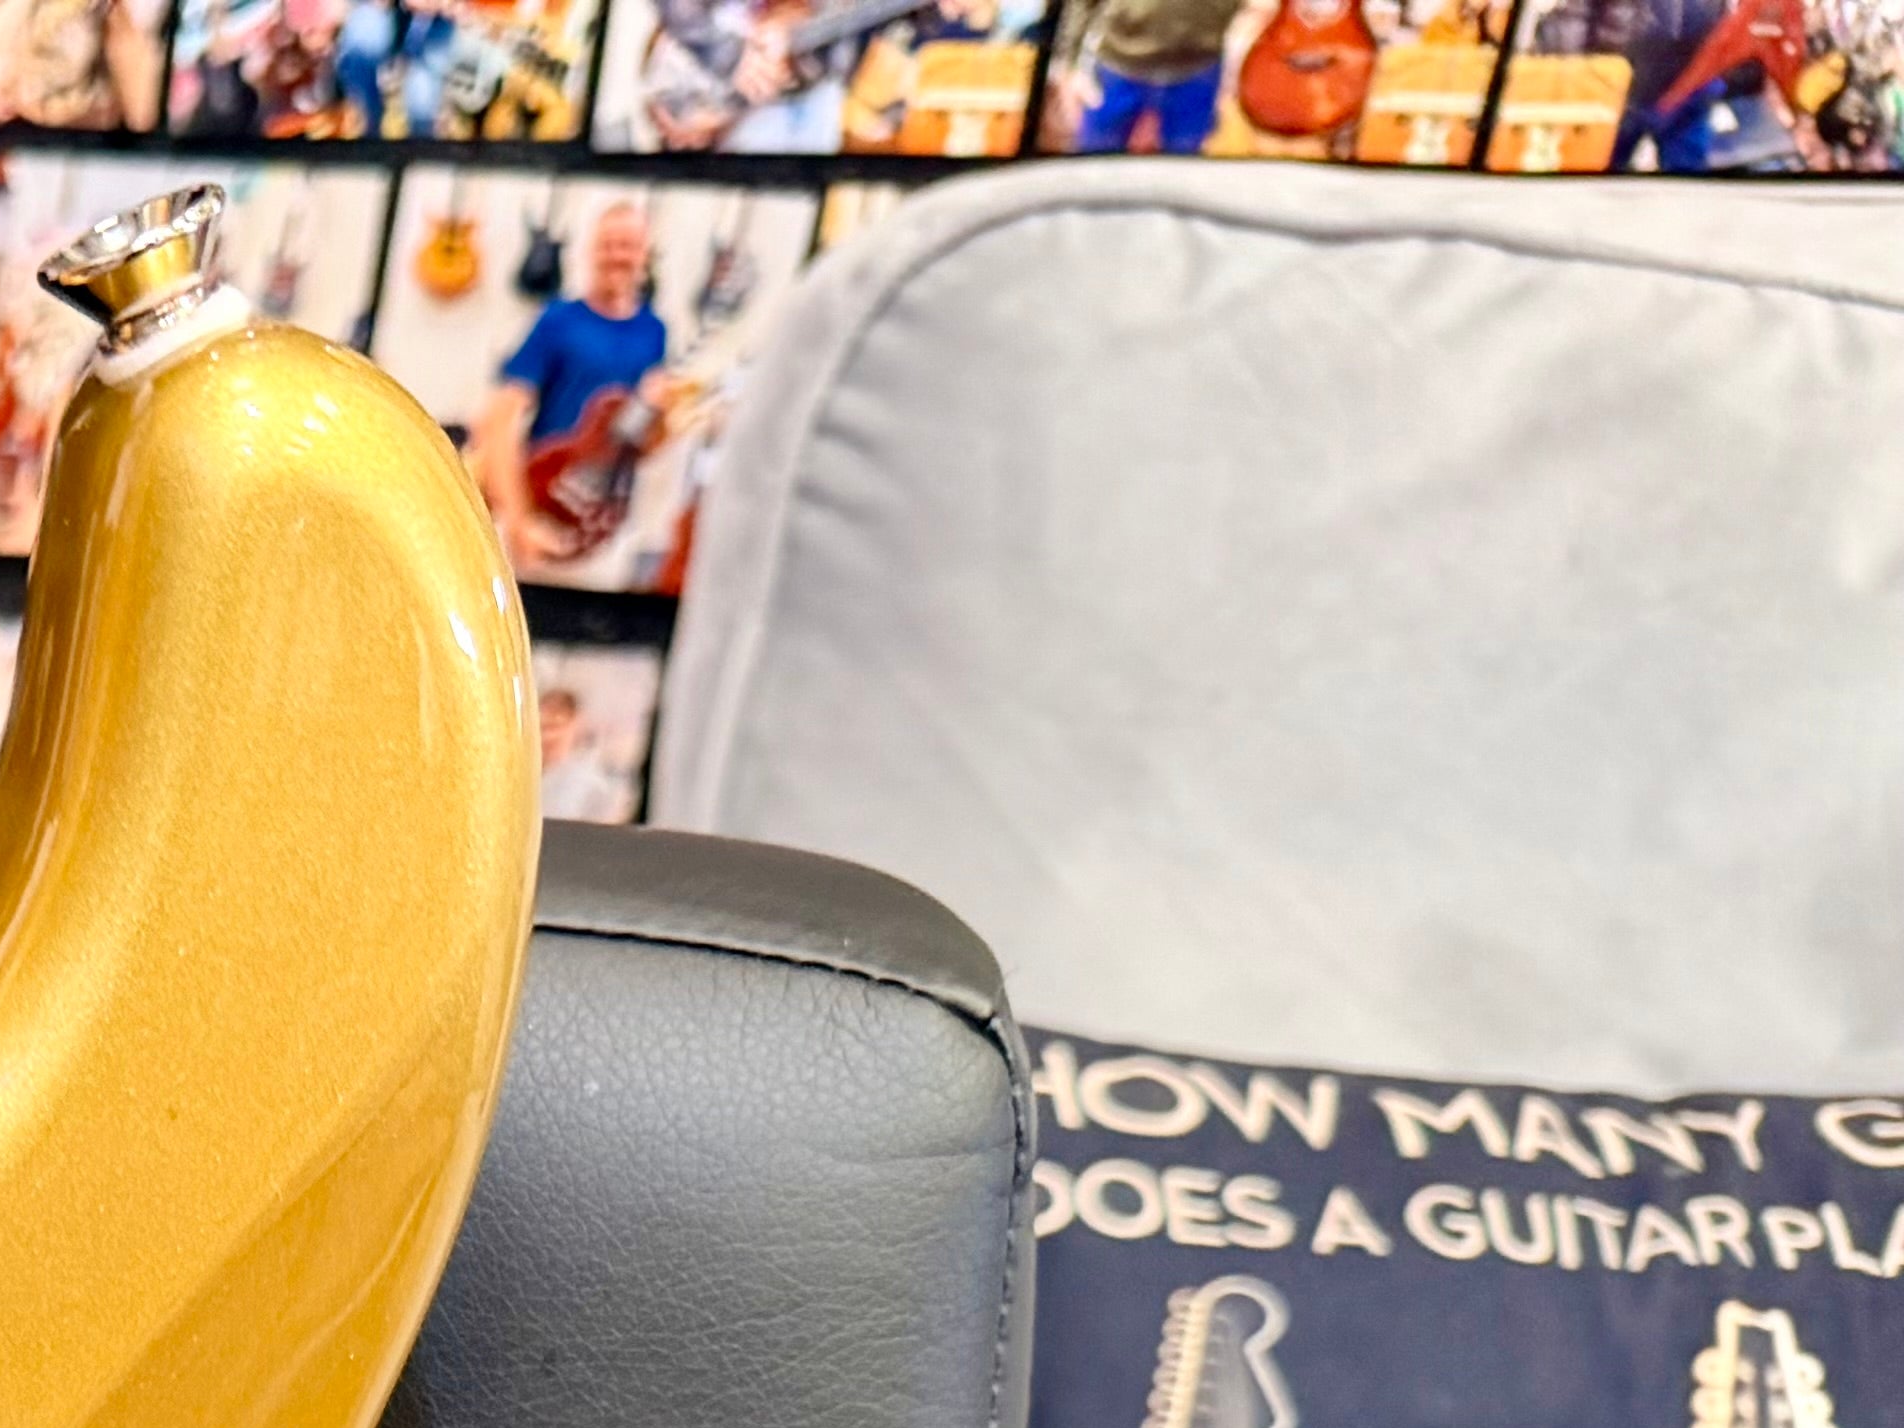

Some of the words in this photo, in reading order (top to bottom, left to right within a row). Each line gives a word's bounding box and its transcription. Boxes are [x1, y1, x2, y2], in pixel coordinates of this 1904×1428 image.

[1372, 1086, 1766, 1180] MANY
[1311, 1185, 1393, 1258] A
[1402, 1183, 1757, 1274] GUITAR
